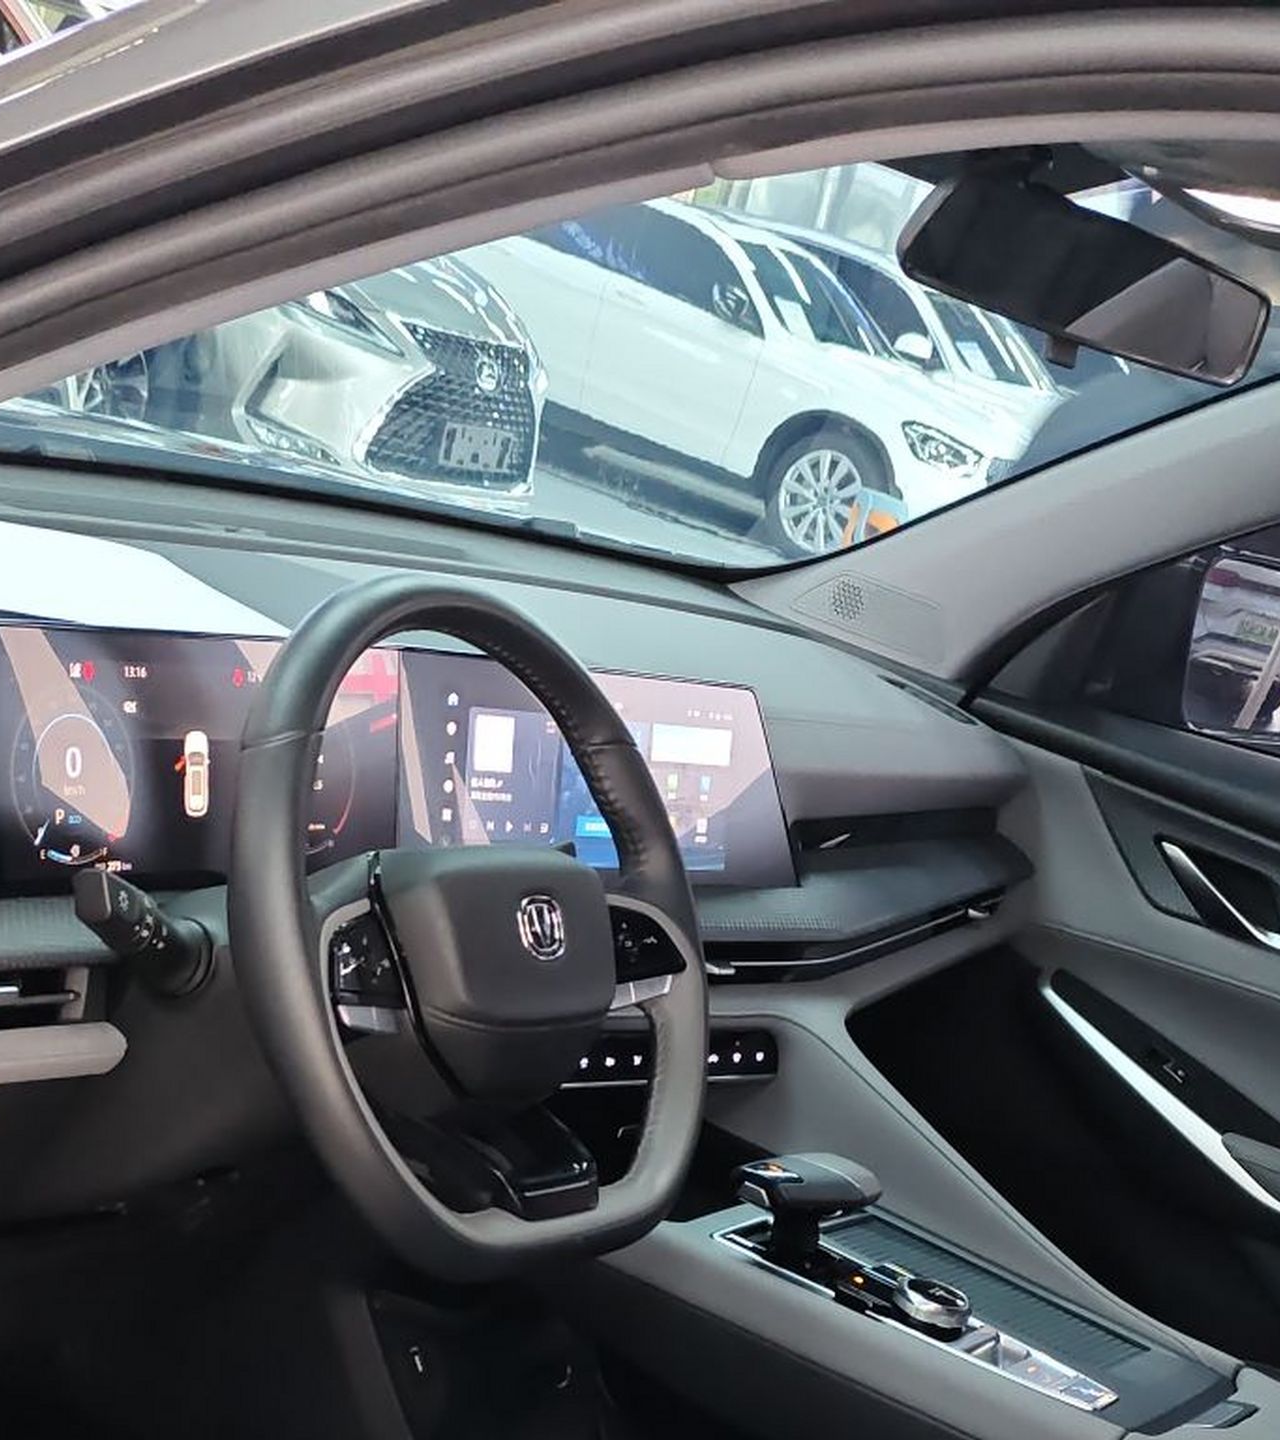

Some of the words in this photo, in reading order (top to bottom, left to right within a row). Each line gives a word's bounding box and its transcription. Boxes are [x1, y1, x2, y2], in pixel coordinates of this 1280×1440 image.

[123, 665, 148, 679] 13:16
[65, 746, 82, 778] 0
[55, 808, 65, 825] P
